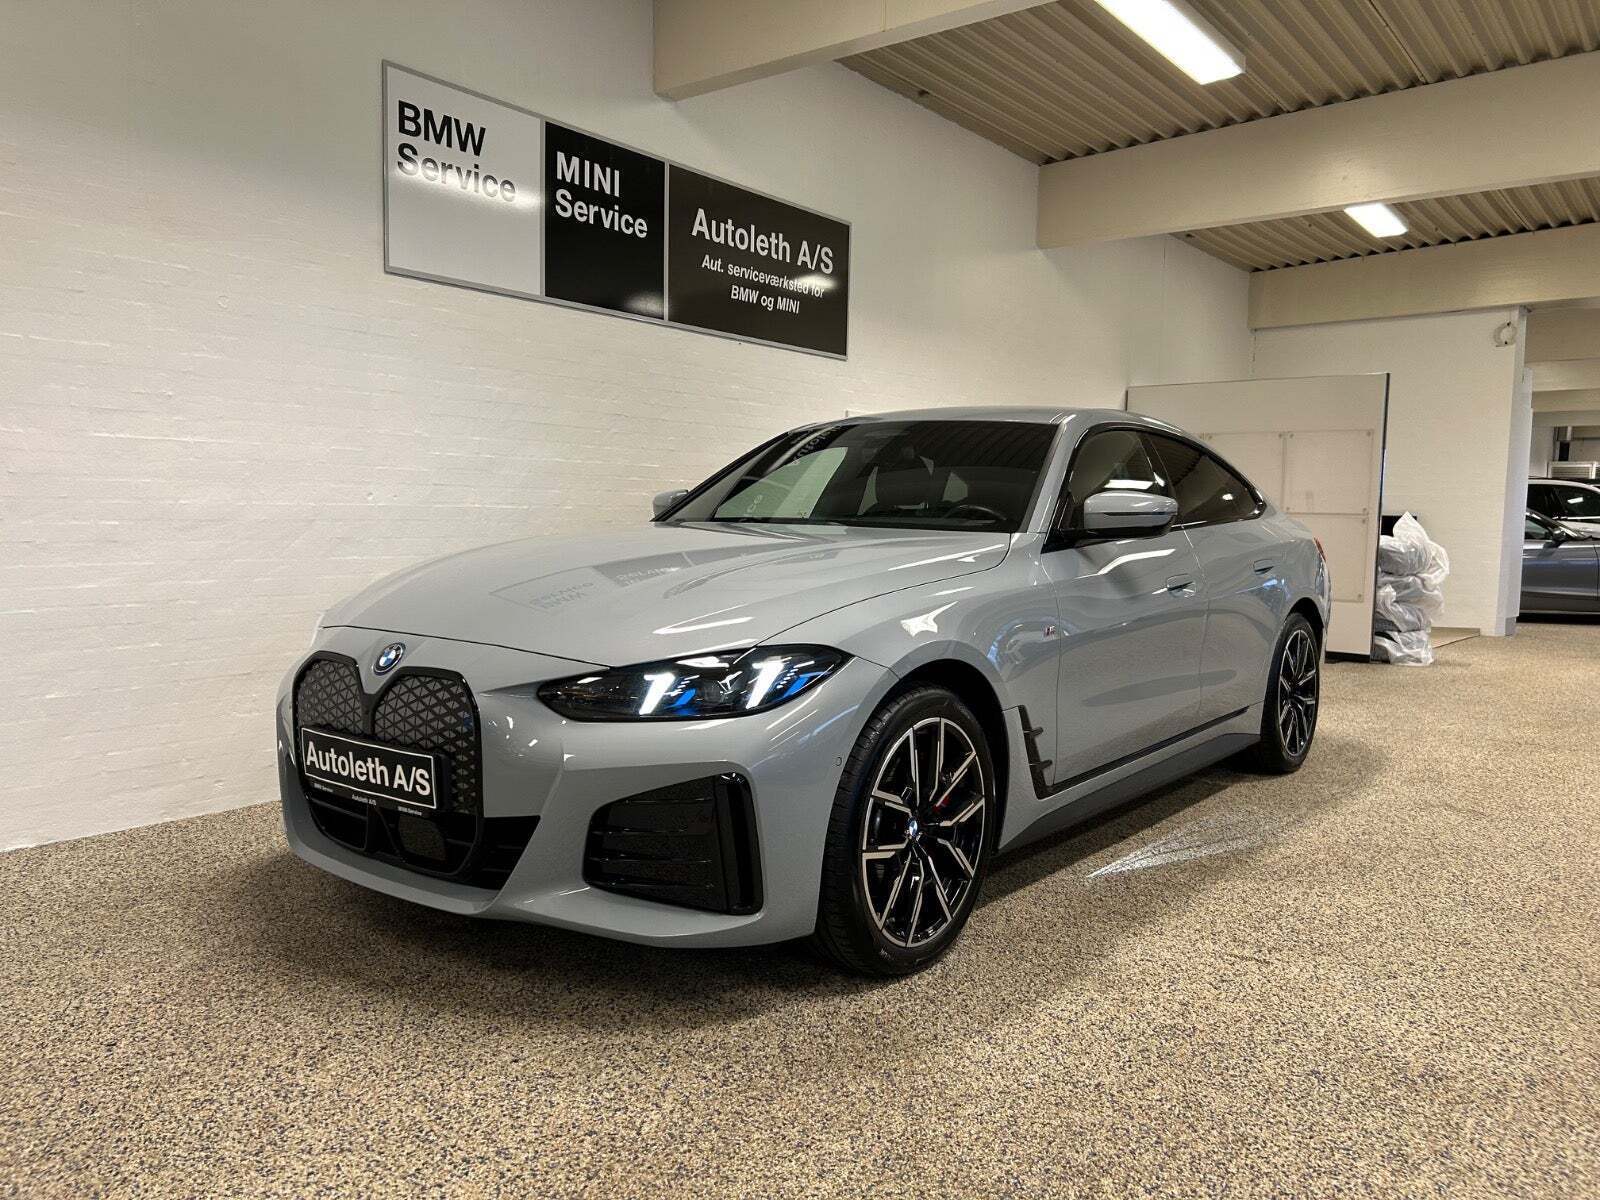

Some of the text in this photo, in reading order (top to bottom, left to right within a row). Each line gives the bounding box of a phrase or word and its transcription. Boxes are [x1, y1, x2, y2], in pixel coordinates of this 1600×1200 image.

[398, 100, 486, 156] BMW
[397, 143, 517, 202] Service
[556, 151, 620, 197] MINI
[555, 189, 648, 238] Service
[691, 208, 833, 274] Autoleth A/S
[701, 254, 825, 298] Aut. serviceværksted for
[731, 284, 800, 314] BMW og MINI
[306, 741, 431, 796] Autoleth A/S
